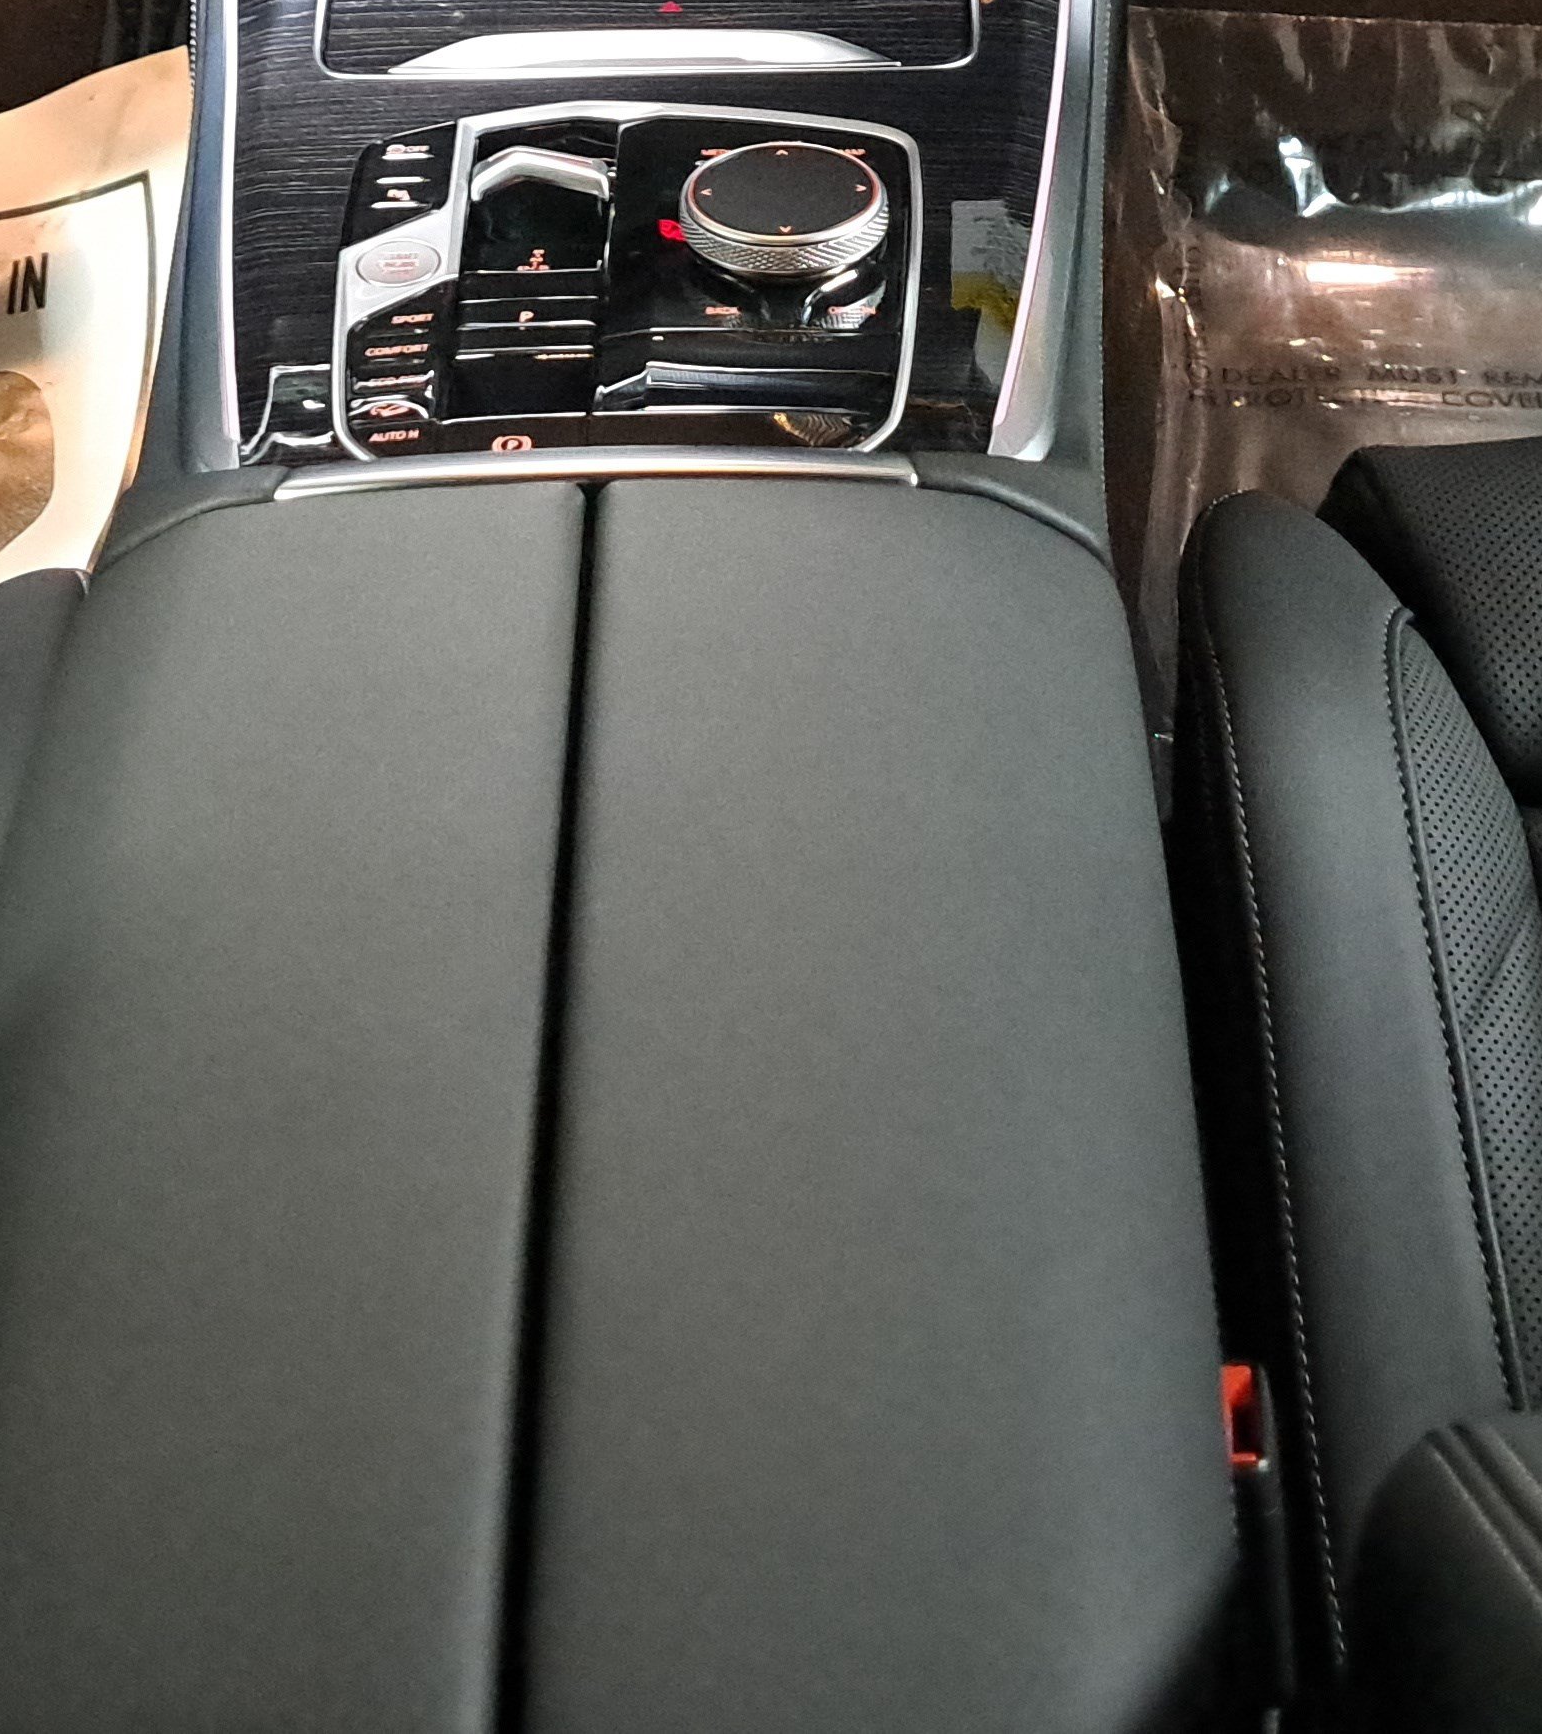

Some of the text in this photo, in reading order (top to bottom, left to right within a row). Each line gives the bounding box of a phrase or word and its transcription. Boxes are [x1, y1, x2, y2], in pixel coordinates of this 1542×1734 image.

[6, 251, 49, 315] IN
[391, 312, 435, 325] SPORT
[364, 343, 430, 358] COMFORT
[369, 428, 420, 442] AUTO H
